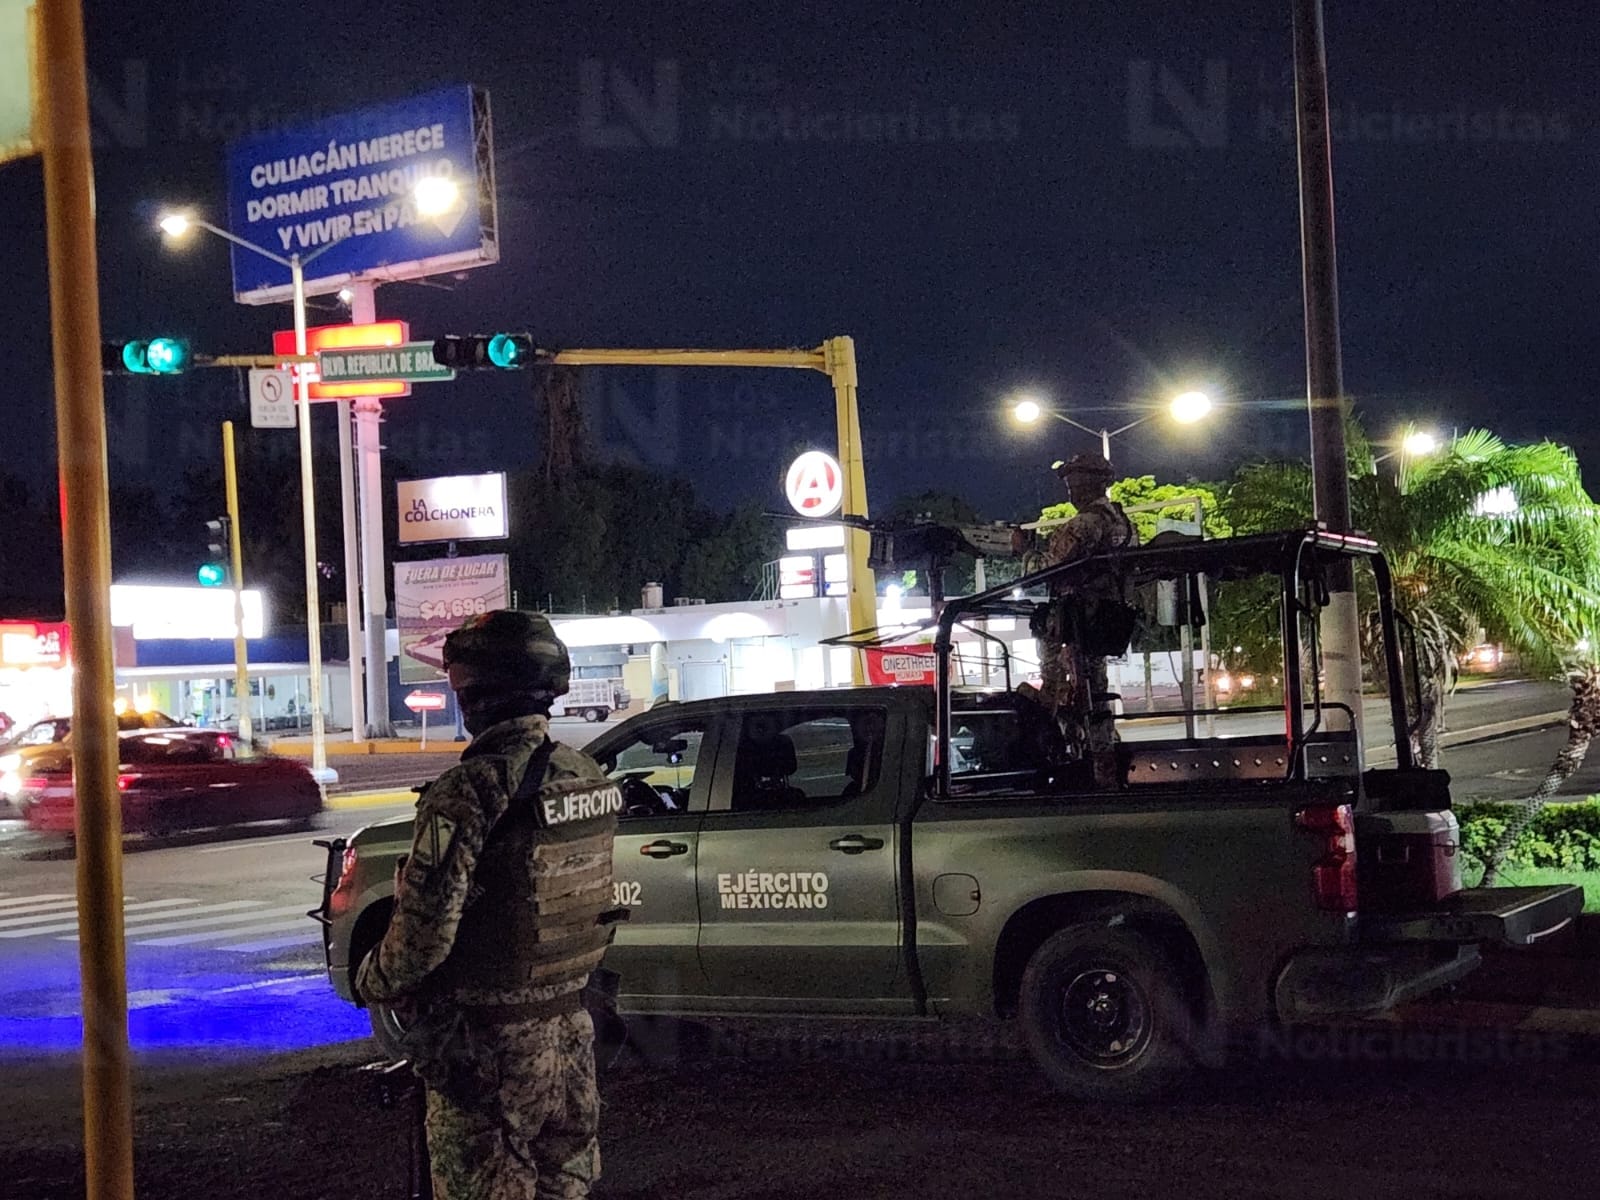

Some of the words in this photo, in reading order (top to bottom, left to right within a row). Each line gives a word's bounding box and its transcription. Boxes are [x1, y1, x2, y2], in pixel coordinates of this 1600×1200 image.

[250, 139, 357, 188] CULIACÁN
[357, 124, 444, 166] MERECE
[247, 183, 329, 222] DORMIR
[277, 226, 294, 250] Y
[295, 213, 350, 248] VIVIR
[349, 208, 384, 236] EN
[400, 353, 413, 373] DE
[404, 506, 495, 523] COLCHONERA
[412, 498, 428, 511] LA
[405, 567, 440, 584] FUERA
[441, 564, 459, 581] DE
[458, 562, 497, 579] LUGAR
[420, 596, 486, 620] $4,696
[543, 786, 623, 825] EJÉRCITO
[717, 869, 829, 894] EJÉRCITO
[720, 893, 829, 909] MEXICANO
